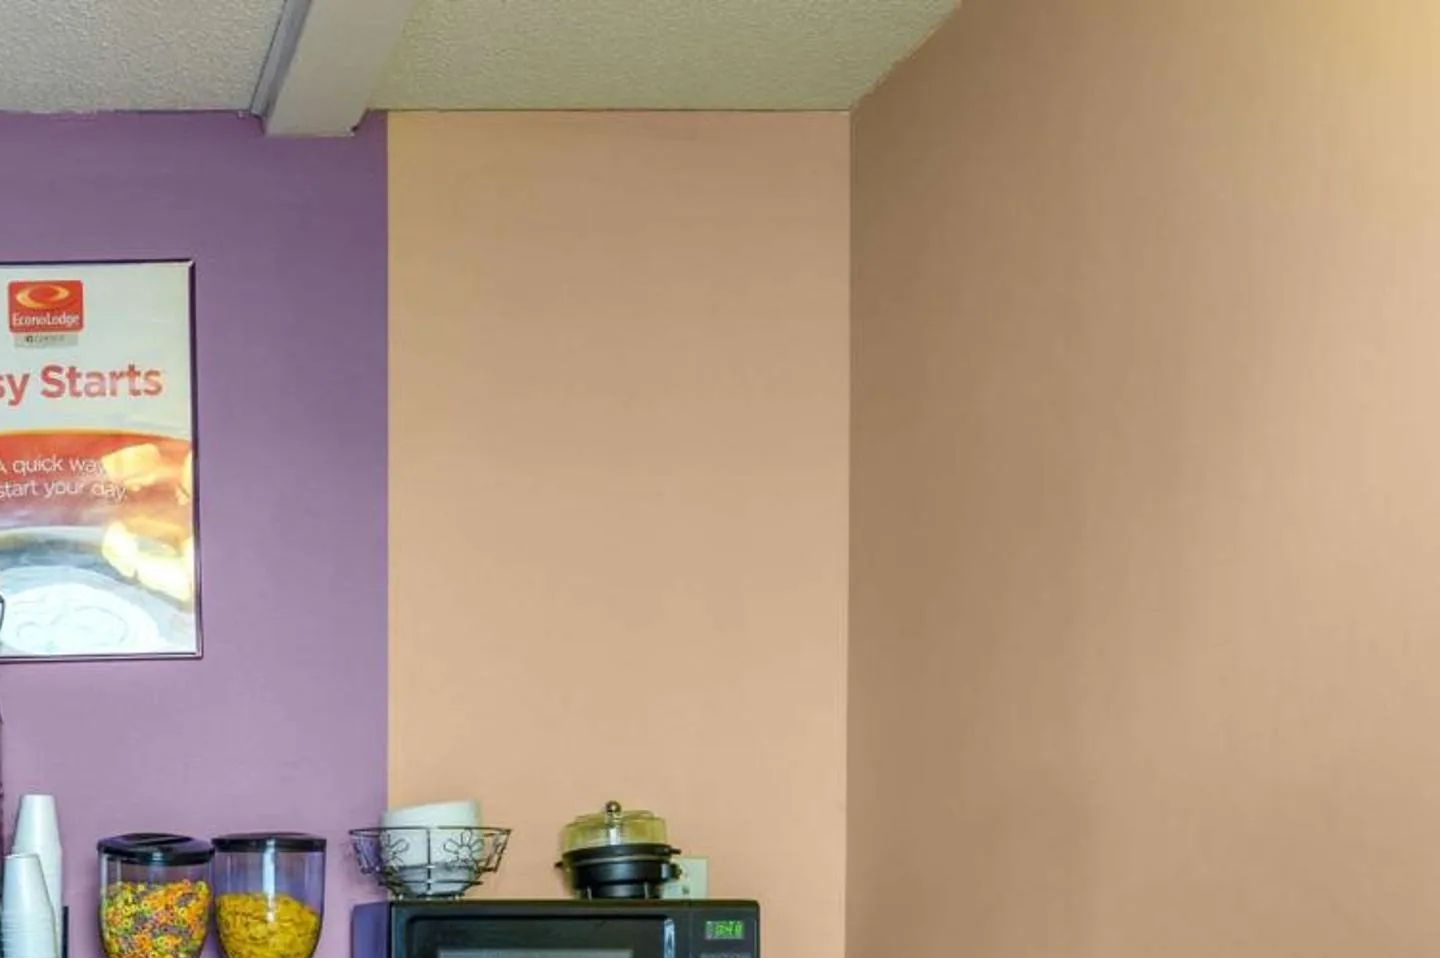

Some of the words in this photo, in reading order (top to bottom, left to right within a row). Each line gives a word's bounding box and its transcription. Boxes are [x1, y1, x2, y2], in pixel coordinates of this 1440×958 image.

[40, 364, 164, 398] Starts
[12, 453, 63, 476] quick
[43, 478, 85, 498] your
